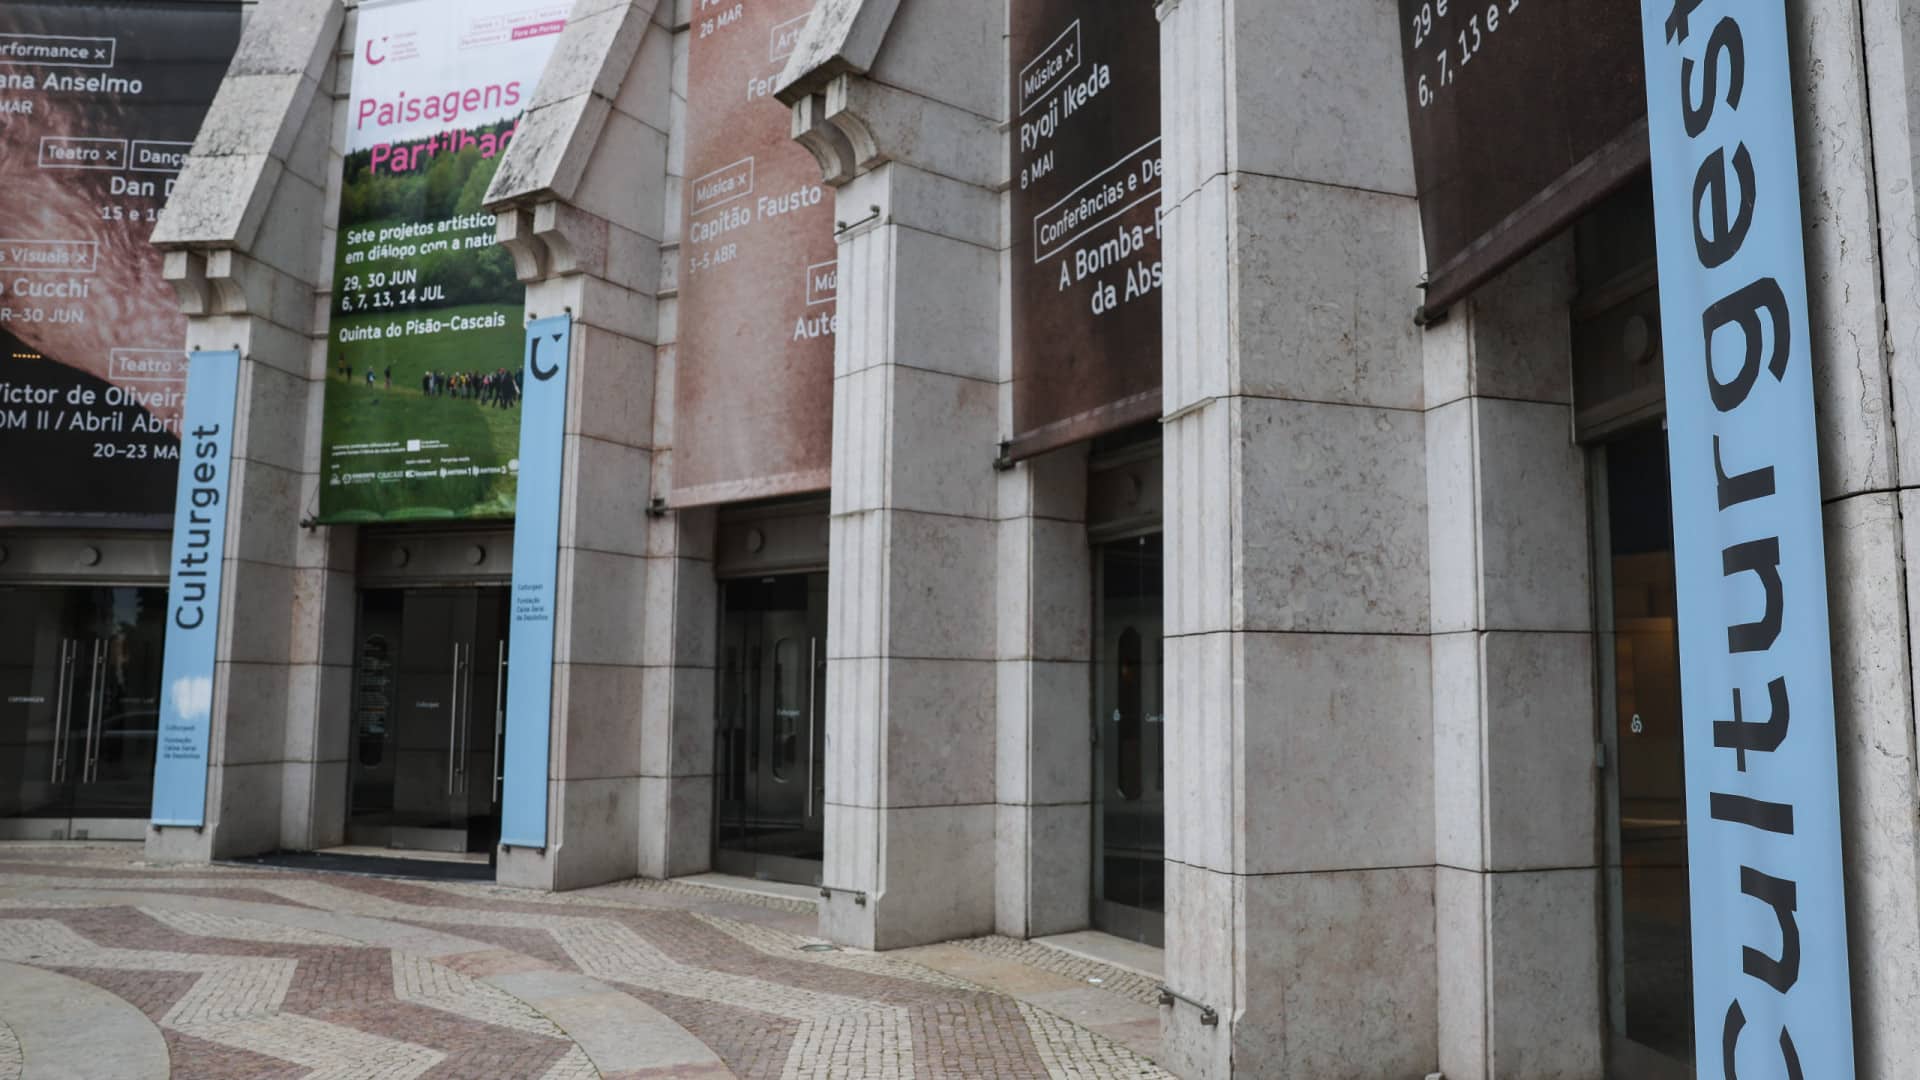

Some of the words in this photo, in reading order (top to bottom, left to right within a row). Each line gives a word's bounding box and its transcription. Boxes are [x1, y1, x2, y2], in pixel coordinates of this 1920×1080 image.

[700, 19, 714, 39] 26
[717, 4, 743, 31] MAR
[1412, 3, 1432, 48] 29
[0, 41, 88, 59] rformance
[1418, 74, 1433, 107] 6,
[1437, 49, 1453, 86] 7,
[1458, 14, 1481, 66] 13
[1486, 4, 1499, 32] e
[42, 71, 143, 94] Anselmo
[1025, 53, 1063, 99] Música
[357, 81, 521, 131] Paisagens
[1020, 98, 1059, 152] Ryoji
[1063, 64, 1111, 119] Ikeda
[49, 145, 100, 161] Teatro
[1020, 168, 1028, 190] 8
[1031, 150, 1054, 182] MAI
[110, 177, 154, 196] Dan
[696, 177, 735, 203] Música
[101, 207, 123, 221] 15
[129, 209, 140, 221] e
[690, 206, 751, 243] Capitão
[756, 185, 822, 221] Fausto
[1040, 181, 1125, 246] Conferências
[1128, 173, 1138, 192] e
[347, 228, 375, 246] Sete
[379, 222, 434, 243] projetos
[437, 212, 497, 233] artístico
[11, 247, 69, 264] Visuais
[345, 250, 364, 265] em
[368, 241, 416, 262] diálogo
[420, 240, 448, 255] com
[452, 239, 460, 251] a
[713, 243, 738, 265] ABR
[13, 277, 90, 299] Cucchi
[343, 275, 362, 292] 29,
[367, 273, 386, 288] 30
[389, 269, 417, 286] JUN
[1058, 260, 1071, 292] A
[1091, 280, 1117, 315] da
[1124, 260, 1162, 302] Abs
[342, 297, 353, 312] 6,
[358, 294, 368, 309] 7,
[373, 292, 395, 307] 13,
[399, 290, 416, 304] 14
[420, 286, 445, 302] JUL
[48, 308, 84, 323] JUN
[339, 323, 382, 343] Quinta
[386, 321, 402, 338] do
[119, 357, 170, 372] Teatro
[0, 382, 59, 404] ictor
[67, 385, 96, 405] de
[105, 385, 186, 407] Oliveir
[69, 411, 123, 432] Abril
[131, 412, 184, 434] Abri
[174, 423, 221, 630] Culturgest
